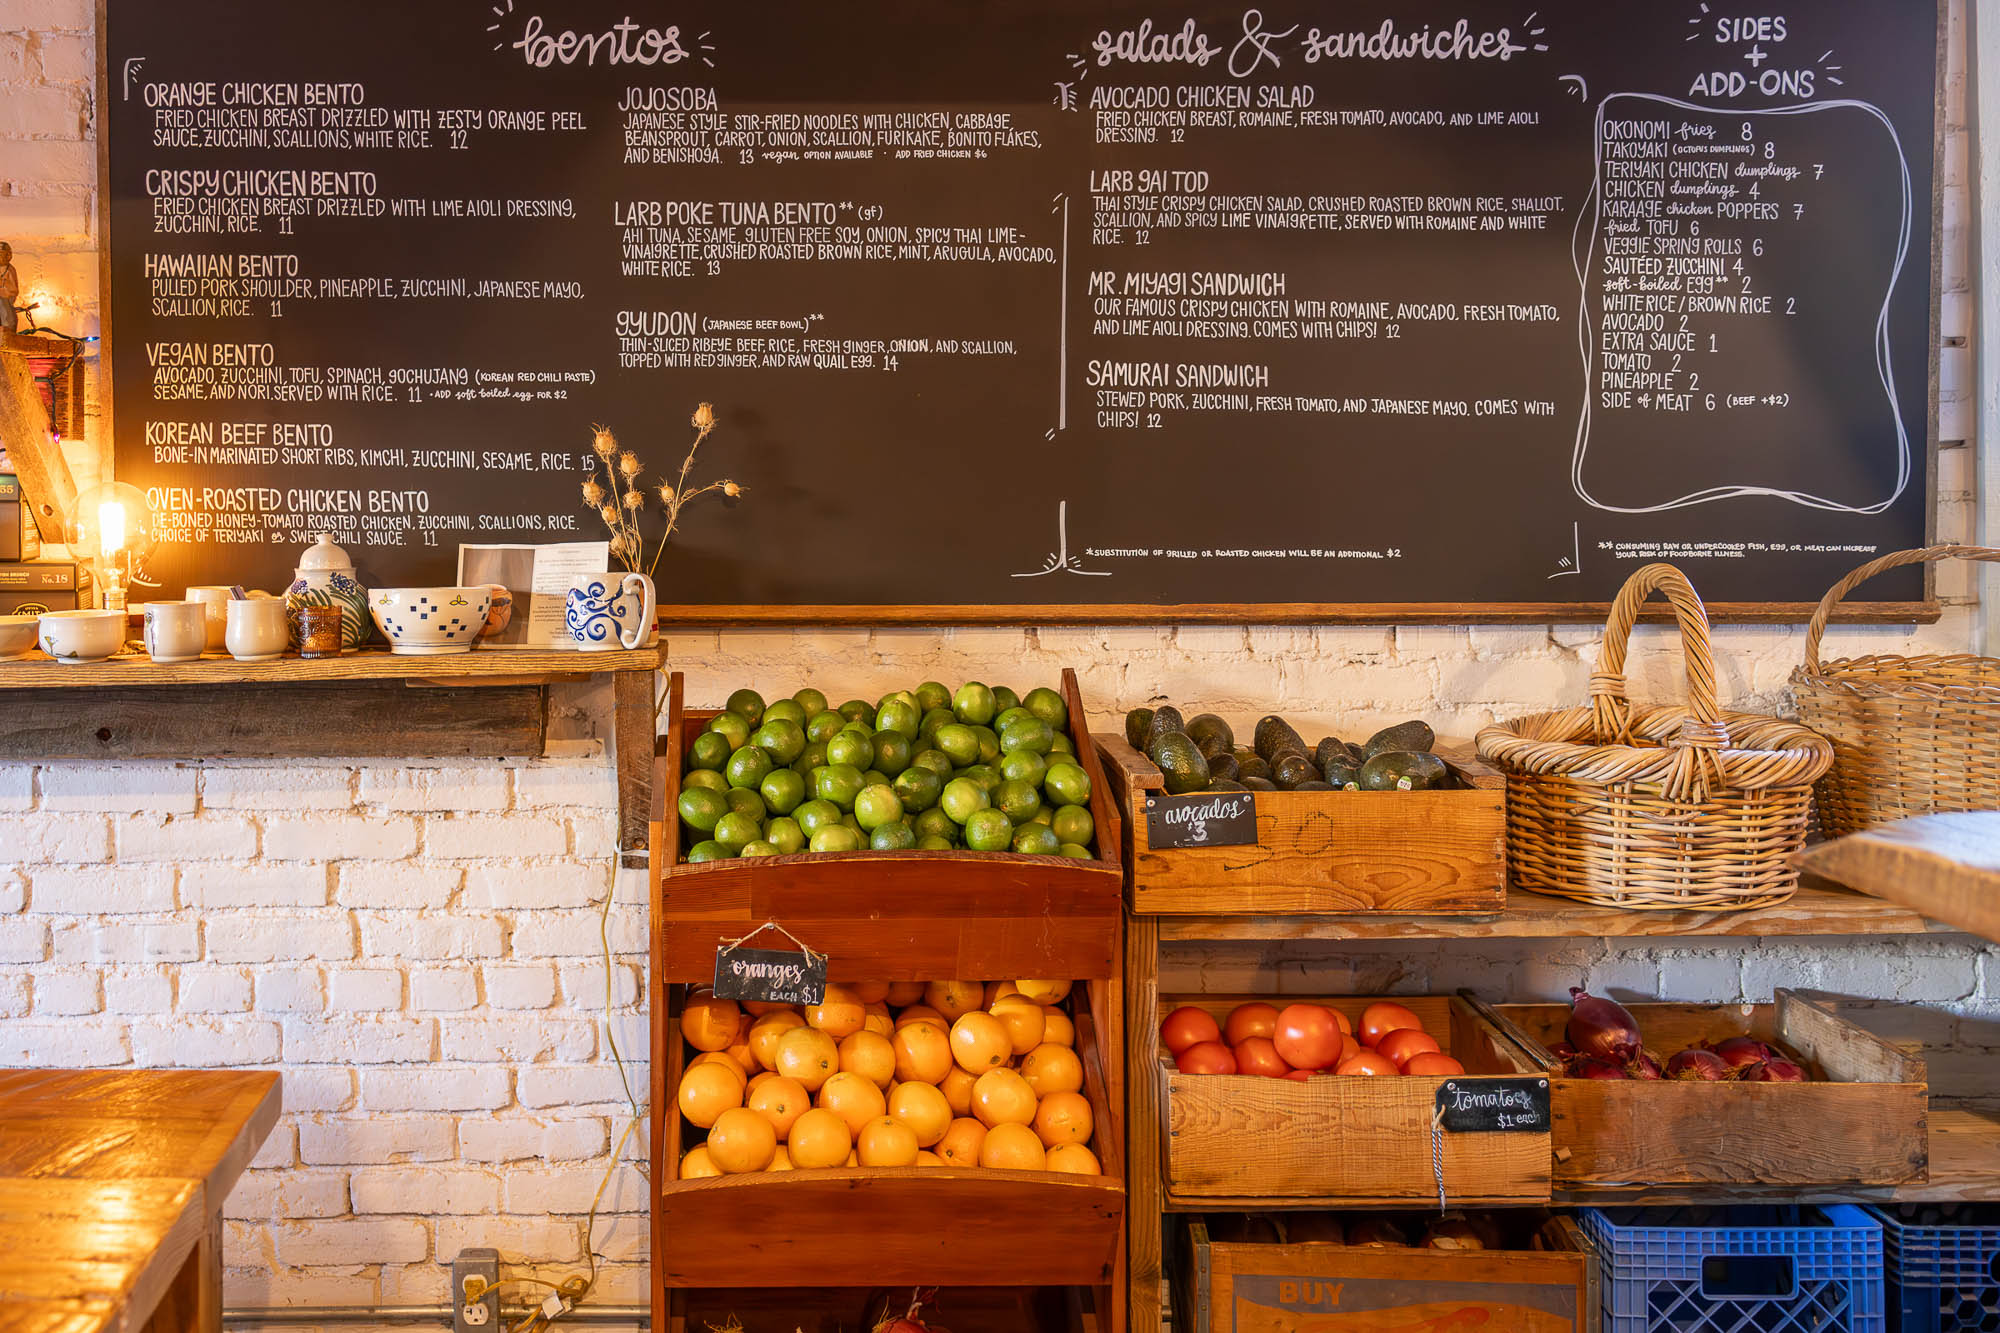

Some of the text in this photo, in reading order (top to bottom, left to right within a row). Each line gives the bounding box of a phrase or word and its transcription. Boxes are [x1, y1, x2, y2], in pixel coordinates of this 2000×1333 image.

[1716, 16, 1786, 42] SIDES
[513, 16, 689, 67] bentos
[1092, 9, 1527, 77] salads & sandwiches
[1744, 44, 1767, 67] +
[223, 83, 297, 105] CHICKEN
[305, 83, 364, 105] BENTO
[1689, 70, 1814, 97] ADD-ONS
[618, 87, 717, 111] JOJOSOBA
[1090, 85, 1314, 109] AVOCADO CHICKEN SALAD
[156, 110, 193, 128] FRIED
[198, 109, 257, 128] CHICKEN
[264, 108, 316, 127] BREAST
[322, 108, 388, 127] DRIZZLED
[394, 110, 430, 129] WITH
[437, 110, 481, 129] ZESTY
[552, 112, 586, 130] PEEL
[623, 113, 685, 129] JAPANESE
[690, 114, 727, 130] STYLE
[735, 114, 800, 130] STIR-FRIED
[804, 114, 858, 130] NOODLES
[864, 114, 891, 129] WITH
[1604, 120, 1752, 141] OKONOMI fries 8
[1604, 142, 1667, 158] TAKOYAKI
[1765, 142, 1774, 159] 8
[1091, 170, 1133, 192] LARB
[1172, 171, 1208, 193] TOD
[1605, 161, 1823, 181] TERIYAKI CHICKEN dumplings 7
[146, 169, 376, 196] CRISPY CHICKEN BENTO
[1606, 180, 1760, 200] CHICKEN dumplings 4
[615, 202, 662, 226] LARB
[667, 201, 713, 225] POKE
[719, 202, 769, 225] TUNA
[1667, 202, 1713, 215] chicken
[1718, 202, 1779, 219] POPPERS
[1794, 204, 1803, 220] 7
[1604, 219, 1699, 236] fried TOFU 6
[1705, 238, 1742, 255] ROLLS
[1753, 239, 1763, 256] 6
[145, 254, 298, 277] HAWAIIAN BENTO
[1666, 258, 1724, 275] ZUCCHINI
[1733, 258, 1744, 275] 4
[1088, 272, 1121, 295] MR.
[1191, 272, 1285, 296] SANDWICH
[1742, 276, 1751, 293] 2
[1603, 294, 1644, 311] WHITE
[1646, 295, 1677, 312] RICE
[1689, 296, 1736, 313] BROWN
[1740, 297, 1771, 313] RICE
[1786, 297, 1795, 314] 2
[703, 317, 752, 332] (JAPANESE
[756, 320, 778, 329] BEEF
[1602, 313, 1688, 332] AVOCADO 2
[1603, 332, 1717, 352] EXTRA SAUCE 1
[213, 344, 273, 366] BENTO
[1601, 352, 1681, 372] TOMATO 2
[1087, 360, 1268, 387] SAMURAI SANDWICH
[1602, 372, 1699, 390] PINEAPPLE 2
[1097, 390, 1145, 407] STEWED
[1192, 394, 1253, 412] ZUCCHINI,
[1256, 396, 1292, 411] FRESH
[1295, 397, 1341, 413] TOMATO,
[1343, 399, 1367, 412] AND
[1371, 399, 1429, 414] JAPANESE
[1475, 400, 1518, 416] COMES
[1524, 401, 1554, 415] WITH
[1602, 392, 1631, 408] SIDE
[1638, 393, 1651, 408] of
[1656, 394, 1693, 411] MEAT
[1706, 394, 1715, 410] 6
[1098, 411, 1162, 427] CHIPS! 12
[146, 421, 332, 446] KOREAN BEEF BENTO
[147, 488, 428, 512] OVEN-ROASTED CHICKEN BENTO
[1387, 548, 1401, 558] $2
[55, 575, 68, 583] 18
[1165, 798, 1245, 824] avocados
[733, 961, 805, 989] oranges
[770, 985, 819, 1004] EACH $1
[1497, 1113, 1514, 1128] $1
[1280, 1281, 1344, 1305] BUY
